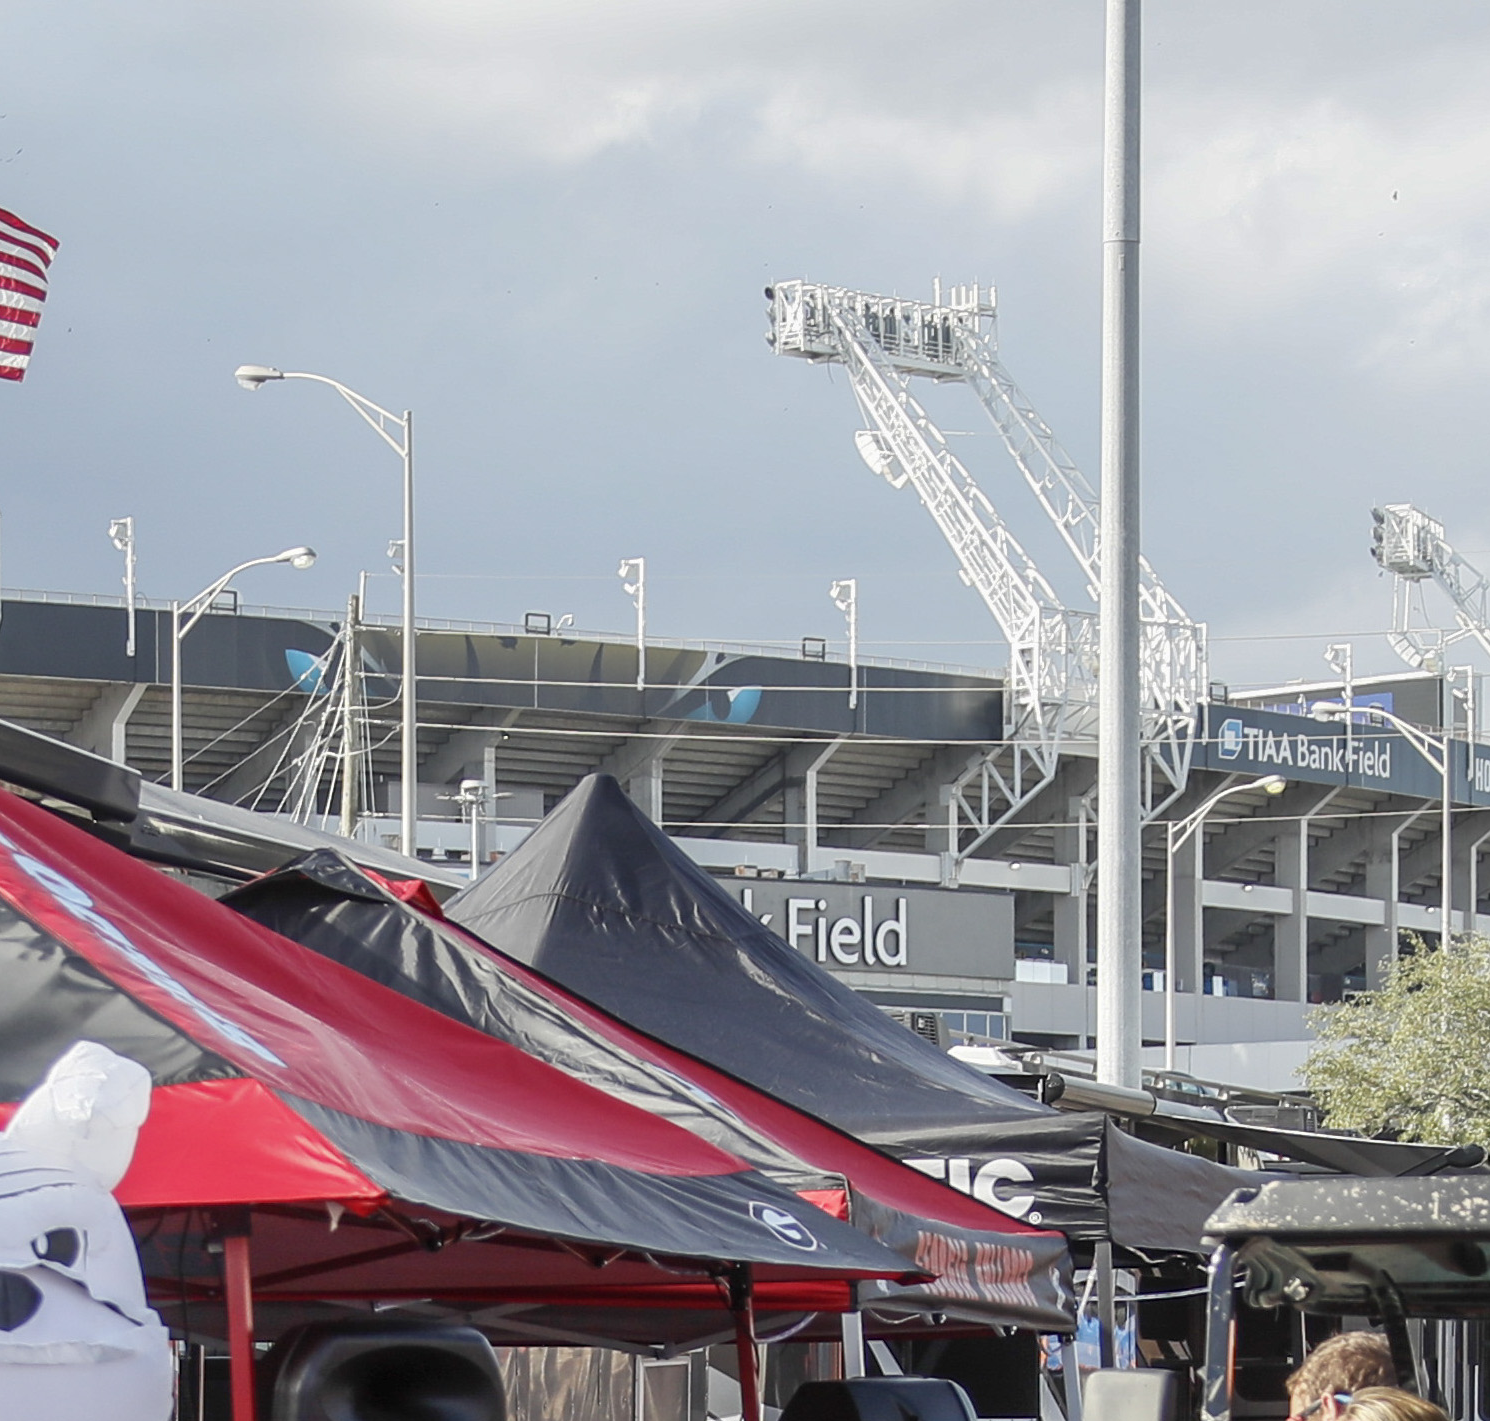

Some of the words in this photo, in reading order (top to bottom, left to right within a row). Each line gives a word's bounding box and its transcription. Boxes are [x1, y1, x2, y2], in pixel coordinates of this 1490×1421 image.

[1243, 727, 1294, 767] TIAA
[1297, 734, 1345, 774] Bank
[1348, 740, 1391, 779] Field
[788, 895, 908, 967] Field
